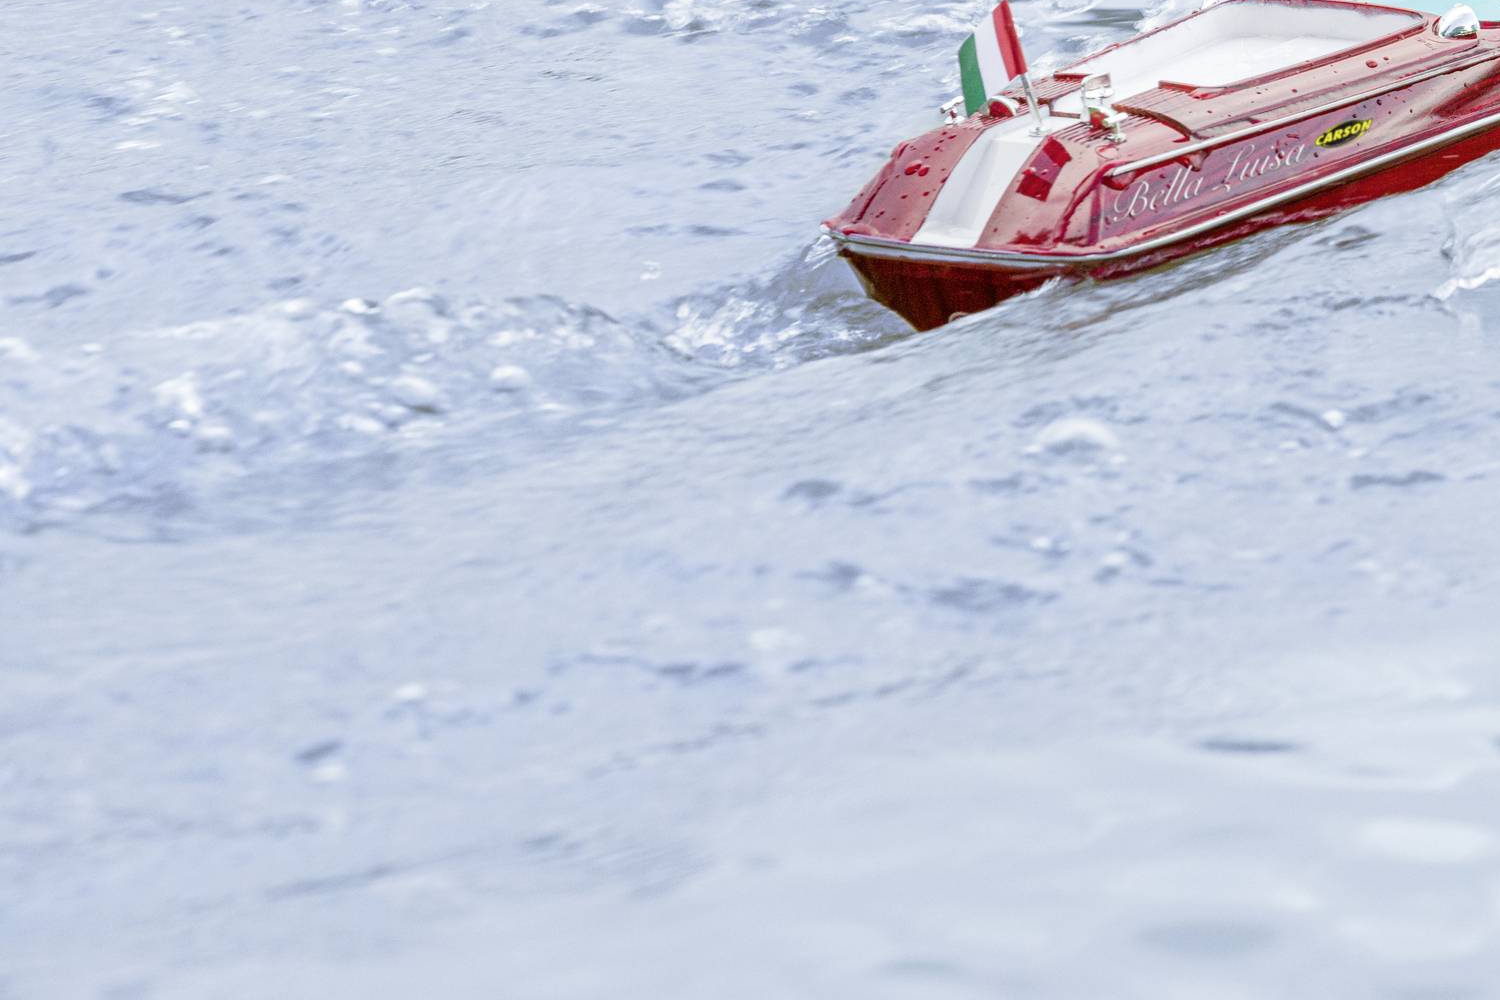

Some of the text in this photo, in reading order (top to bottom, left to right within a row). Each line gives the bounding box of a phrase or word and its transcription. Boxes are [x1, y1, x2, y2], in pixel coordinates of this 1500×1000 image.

[1315, 119, 1373, 147] CARSON
[1113, 144, 1306, 221] Bella Luisa
